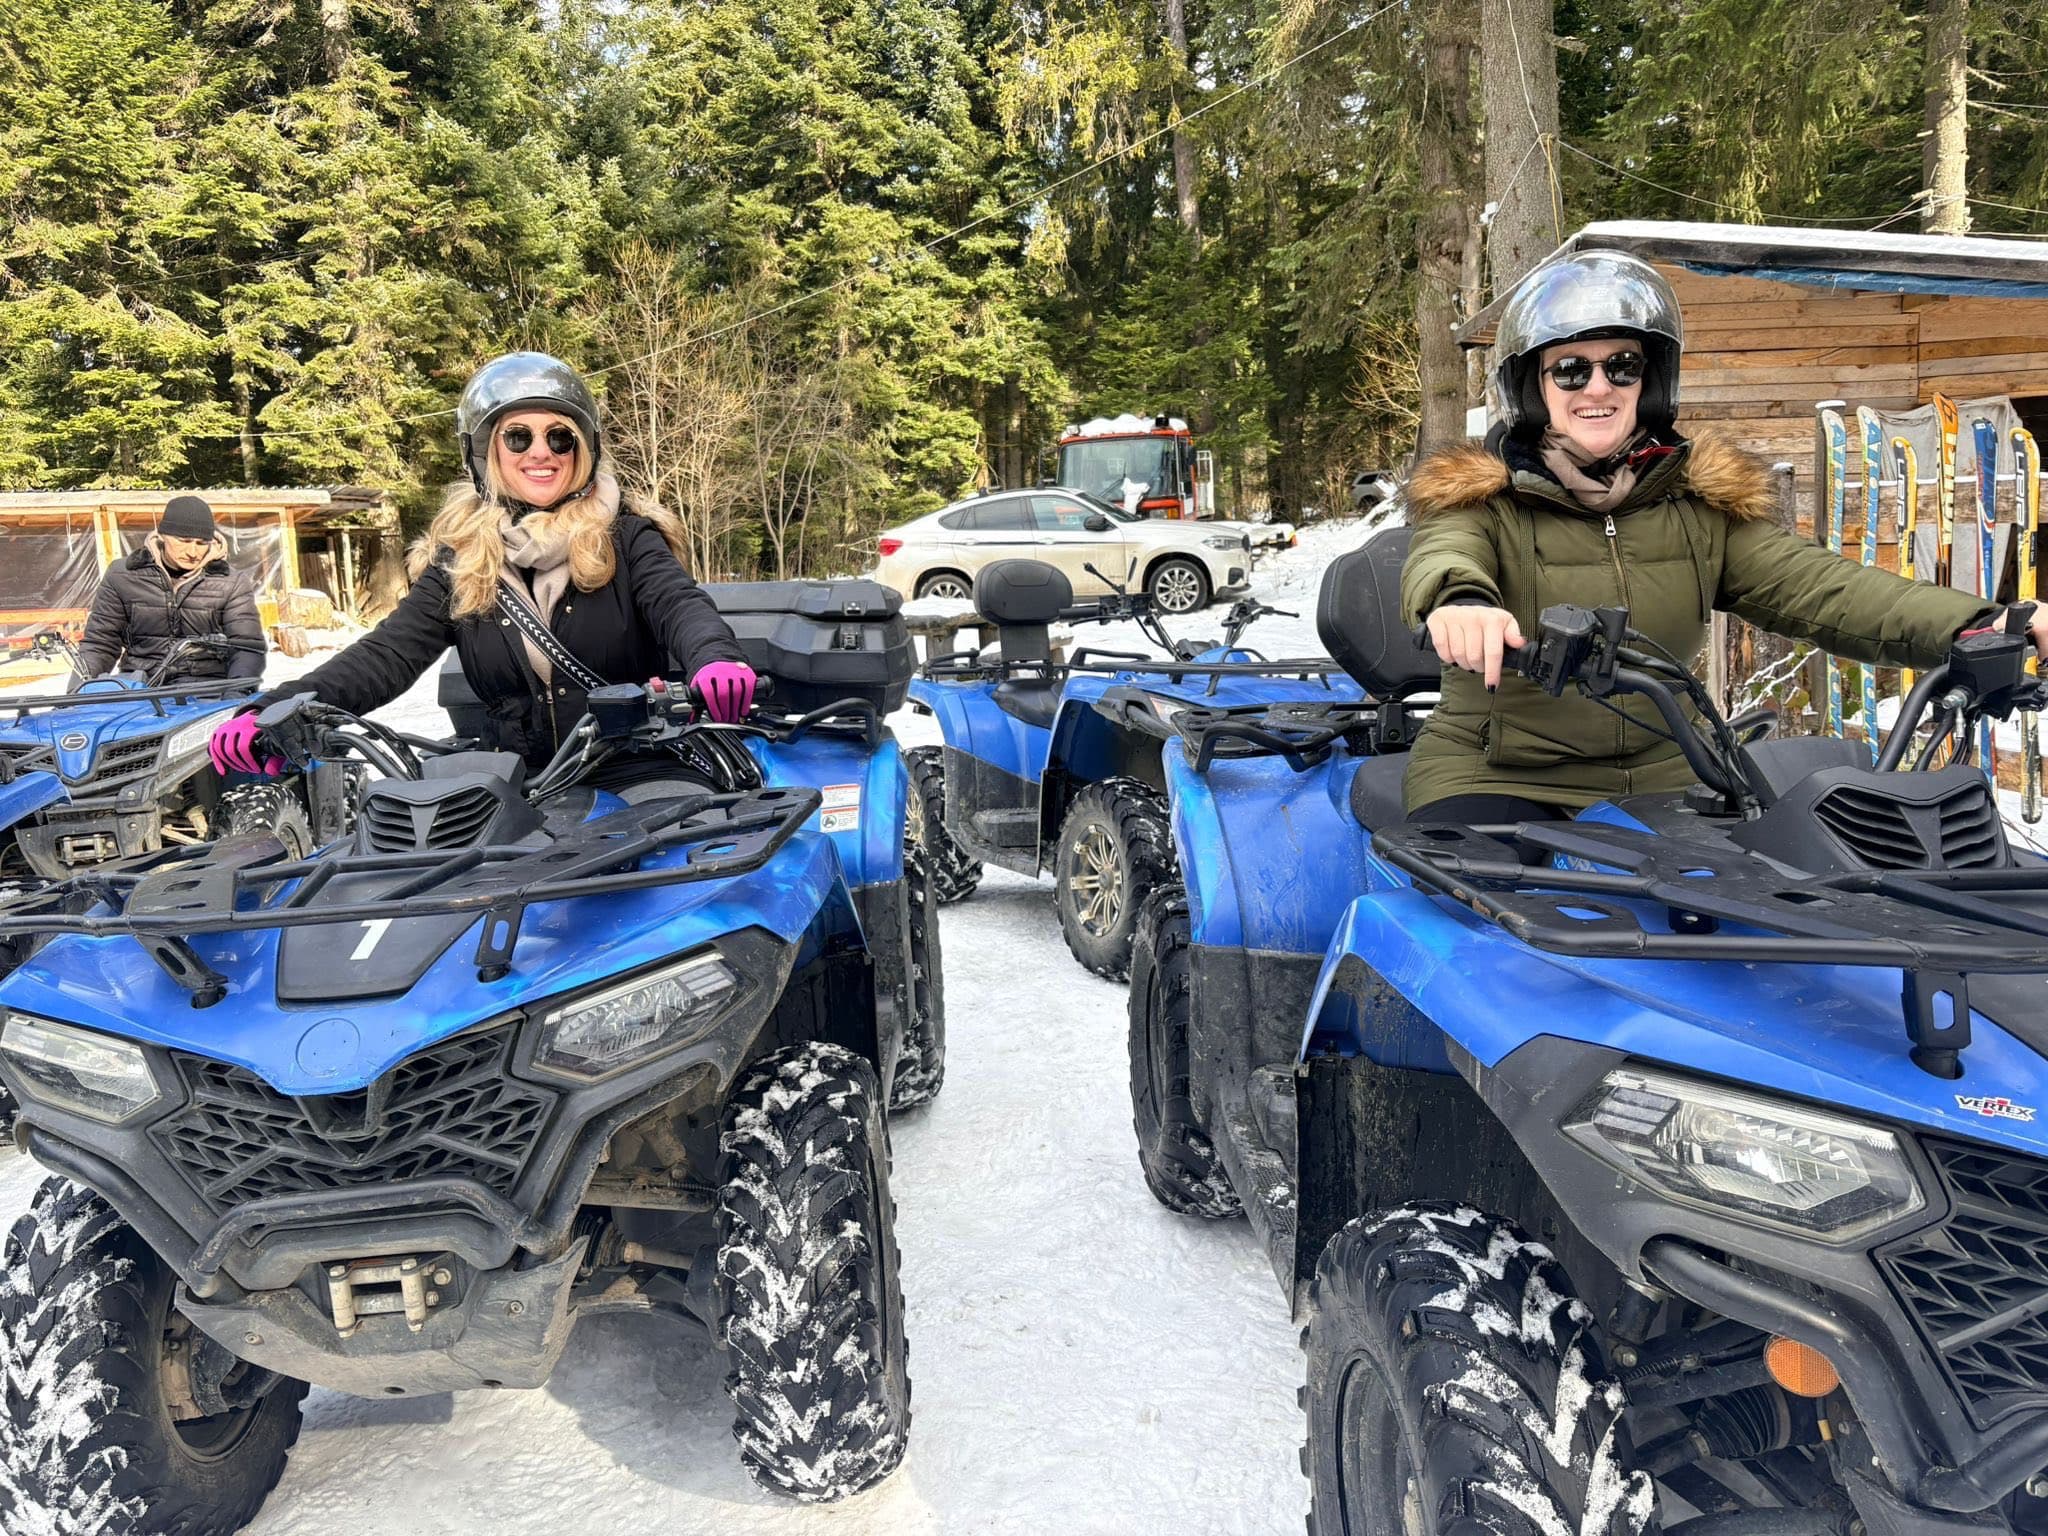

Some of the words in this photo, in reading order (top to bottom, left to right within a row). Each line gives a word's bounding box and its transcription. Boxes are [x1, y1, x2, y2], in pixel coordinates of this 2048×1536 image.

[1897, 458, 1906, 527] elan
[2015, 450, 2025, 527] elan
[1959, 1097, 2031, 1117] VERTEX
